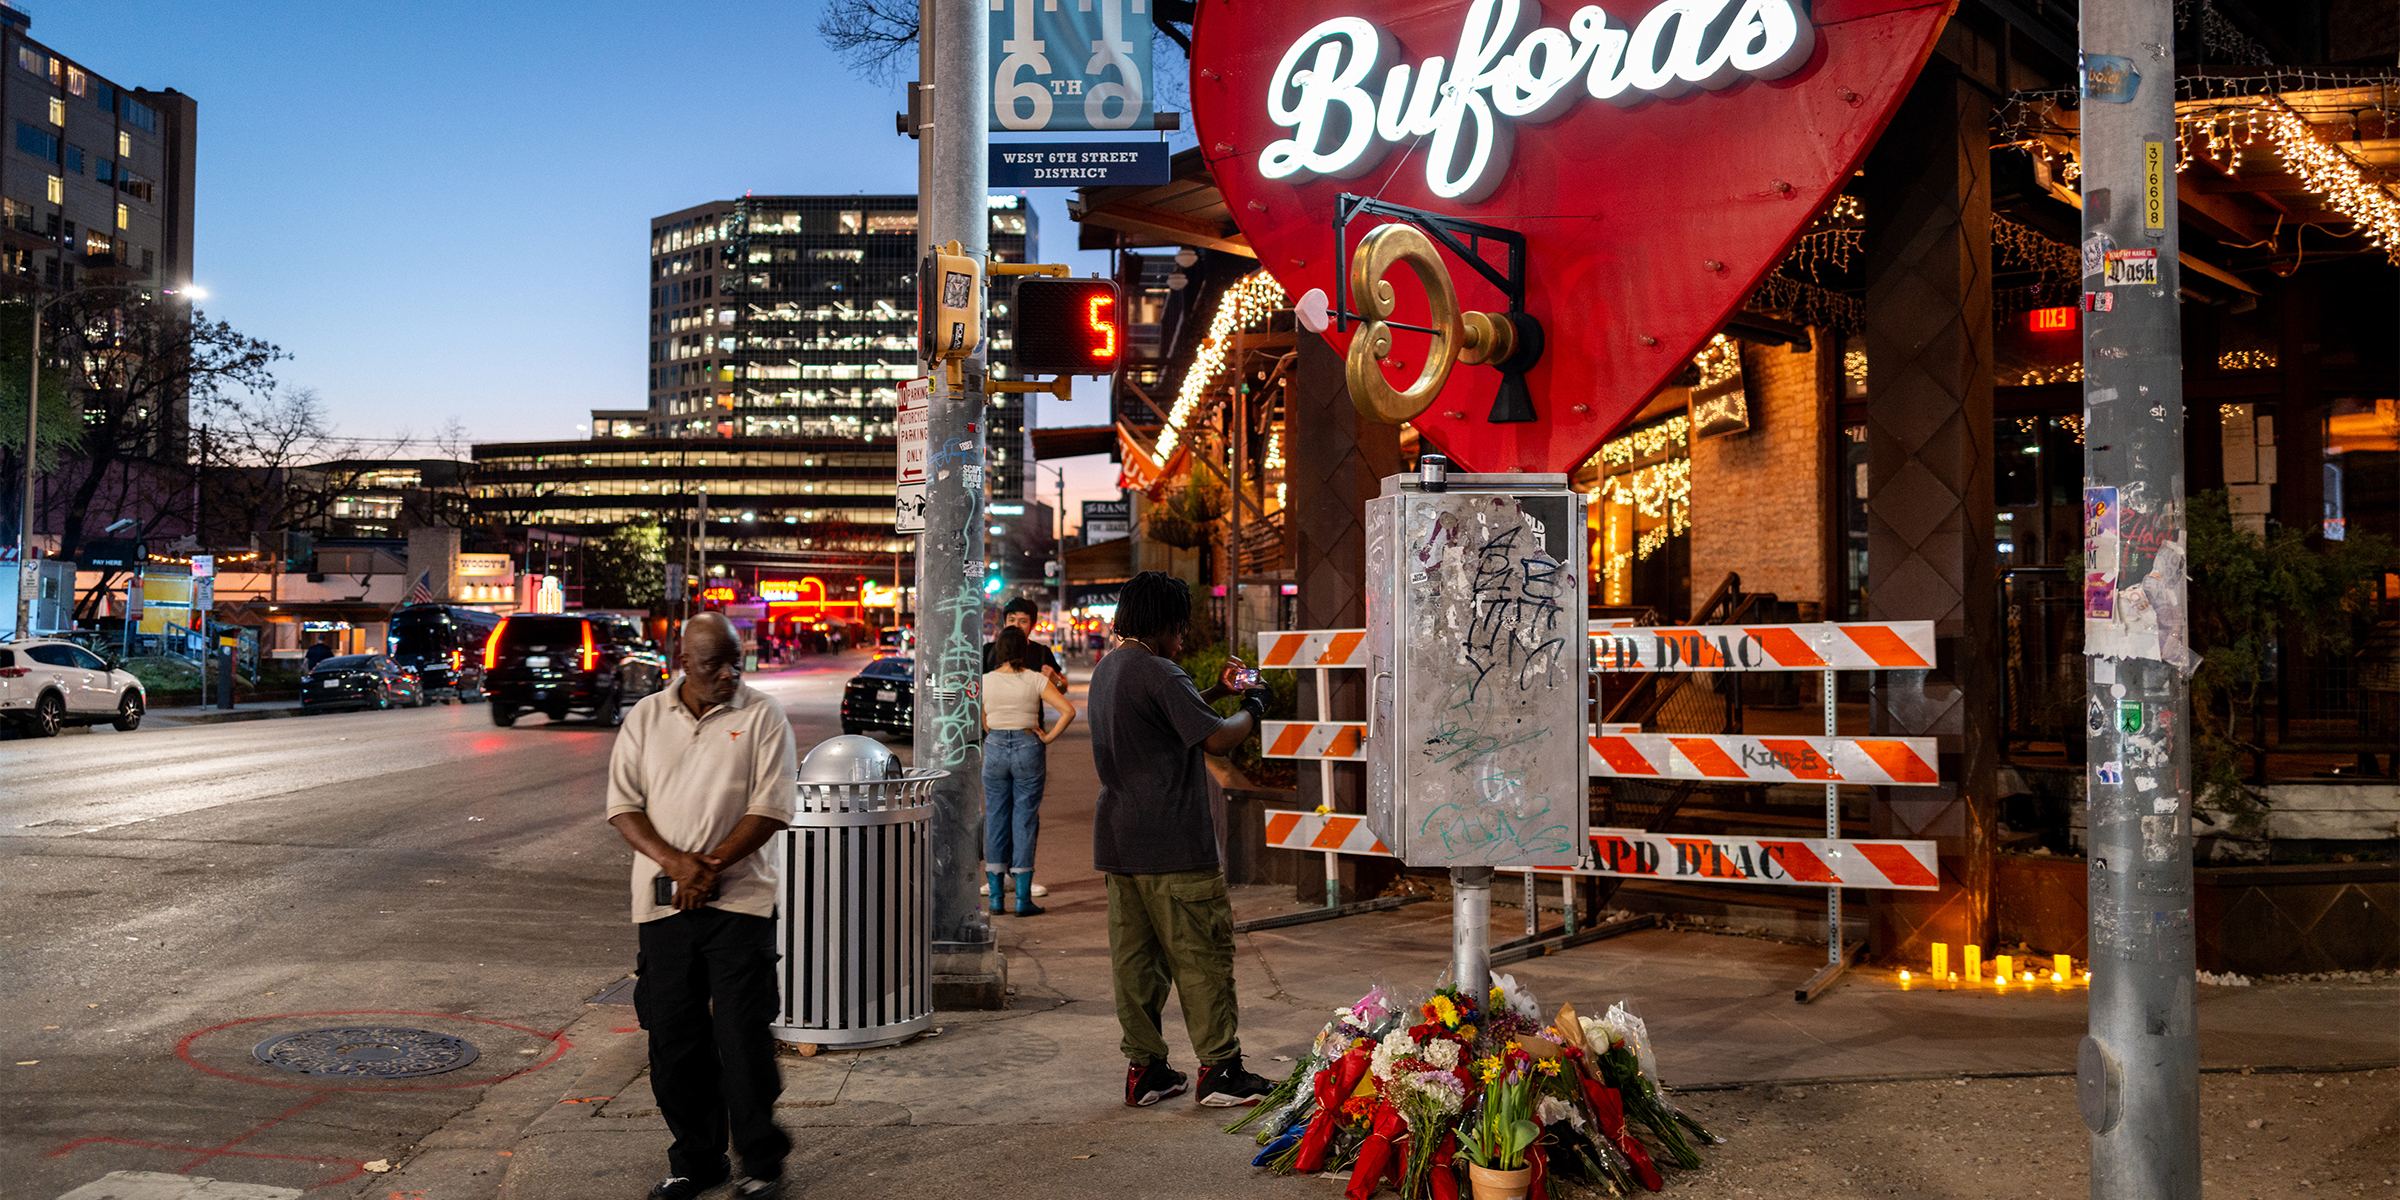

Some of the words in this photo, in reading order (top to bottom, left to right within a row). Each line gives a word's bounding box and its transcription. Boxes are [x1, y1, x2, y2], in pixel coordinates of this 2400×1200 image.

[1003, 153, 1044, 164] WEST
[1049, 152, 1077, 163] 6TH
[1081, 152, 1138, 163] STREET
[1034, 168, 1107, 179] DISTRICT
[2149, 147, 2159, 224] 376608
[1089, 294, 1115, 357] 5
[897, 387, 907, 407] NO
[901, 428, 928, 443] PARKING
[906, 448, 923, 463] ONLY
[460, 559, 506, 569] WOODY'S
[1655, 634, 1763, 669] DTAC
[1580, 839, 1660, 875] APD
[1675, 843, 1785, 880] DTAC
